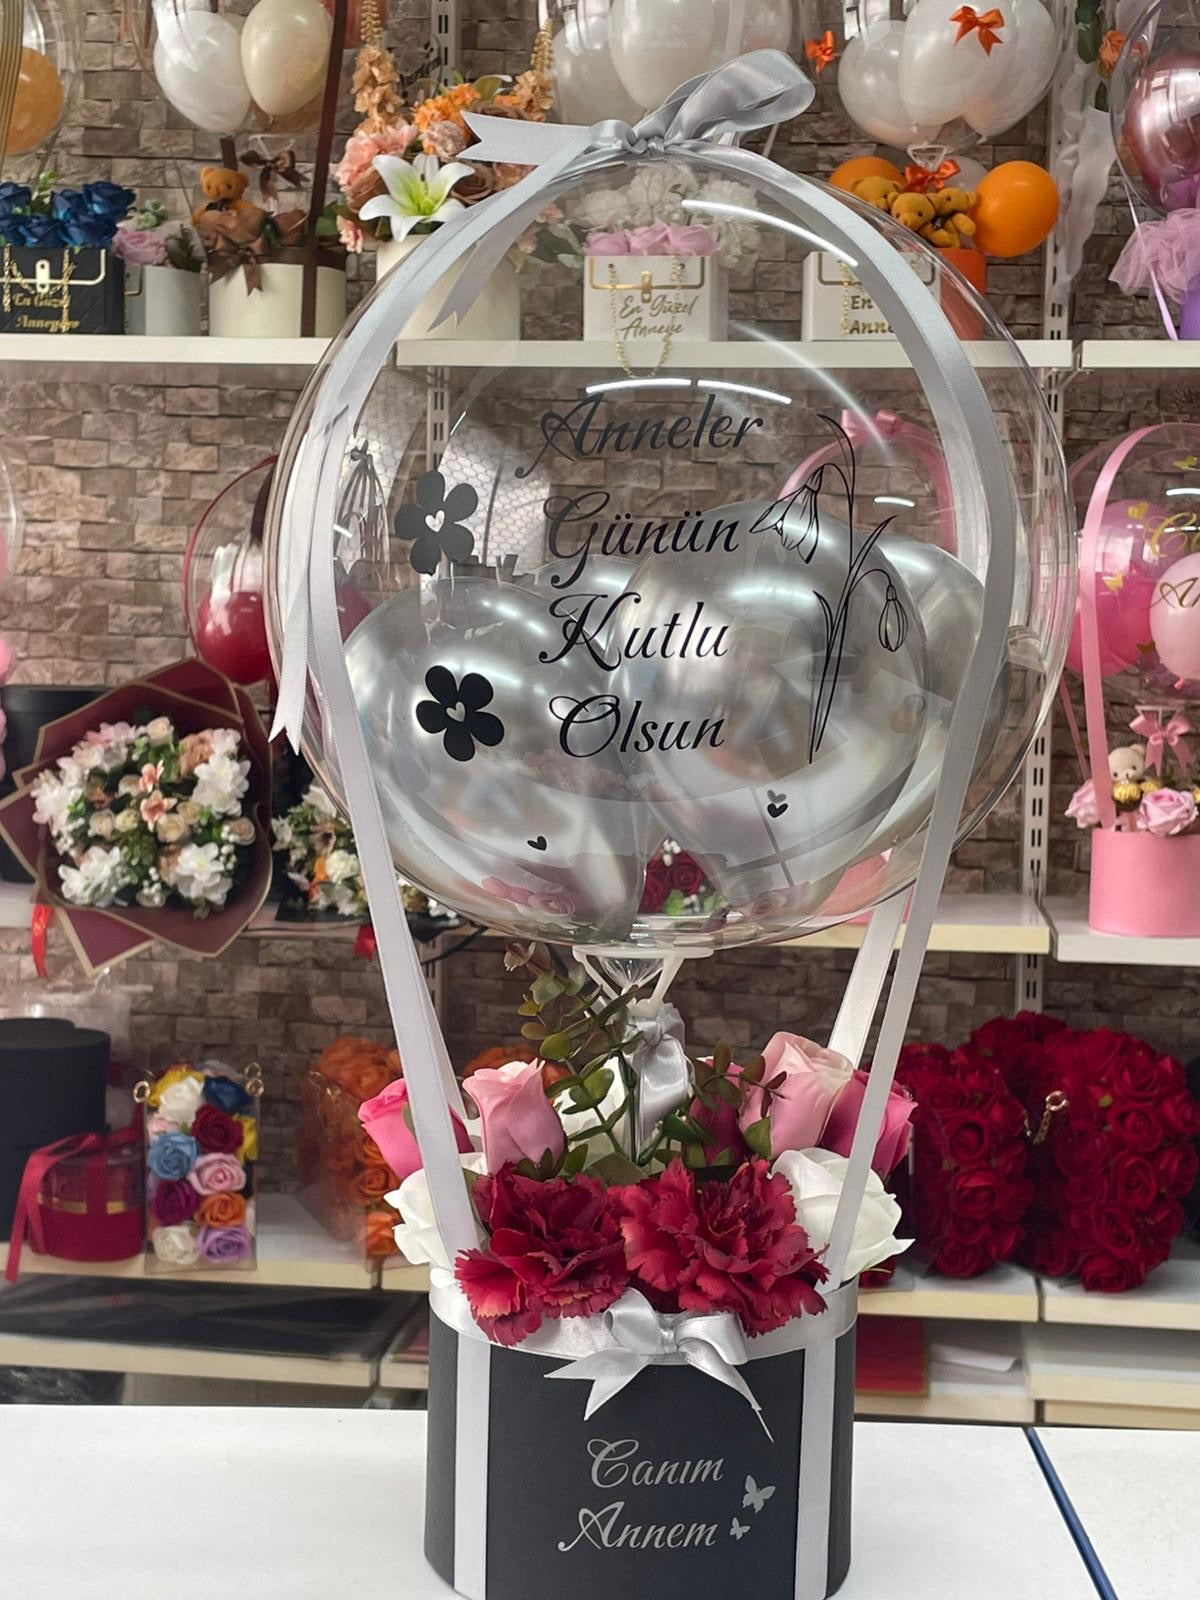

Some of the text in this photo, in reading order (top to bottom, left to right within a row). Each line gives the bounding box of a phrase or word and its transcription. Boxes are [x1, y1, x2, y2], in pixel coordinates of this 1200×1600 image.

[619, 294, 643, 319] En
[851, 294, 873, 310] En
[514, 393, 764, 479] Anneler
[542, 491, 740, 590] Günün
[538, 591, 731, 673] Kutlu
[548, 694, 726, 758] Olsun
[587, 1438, 724, 1489] Canım
[557, 1501, 719, 1552] Annem
